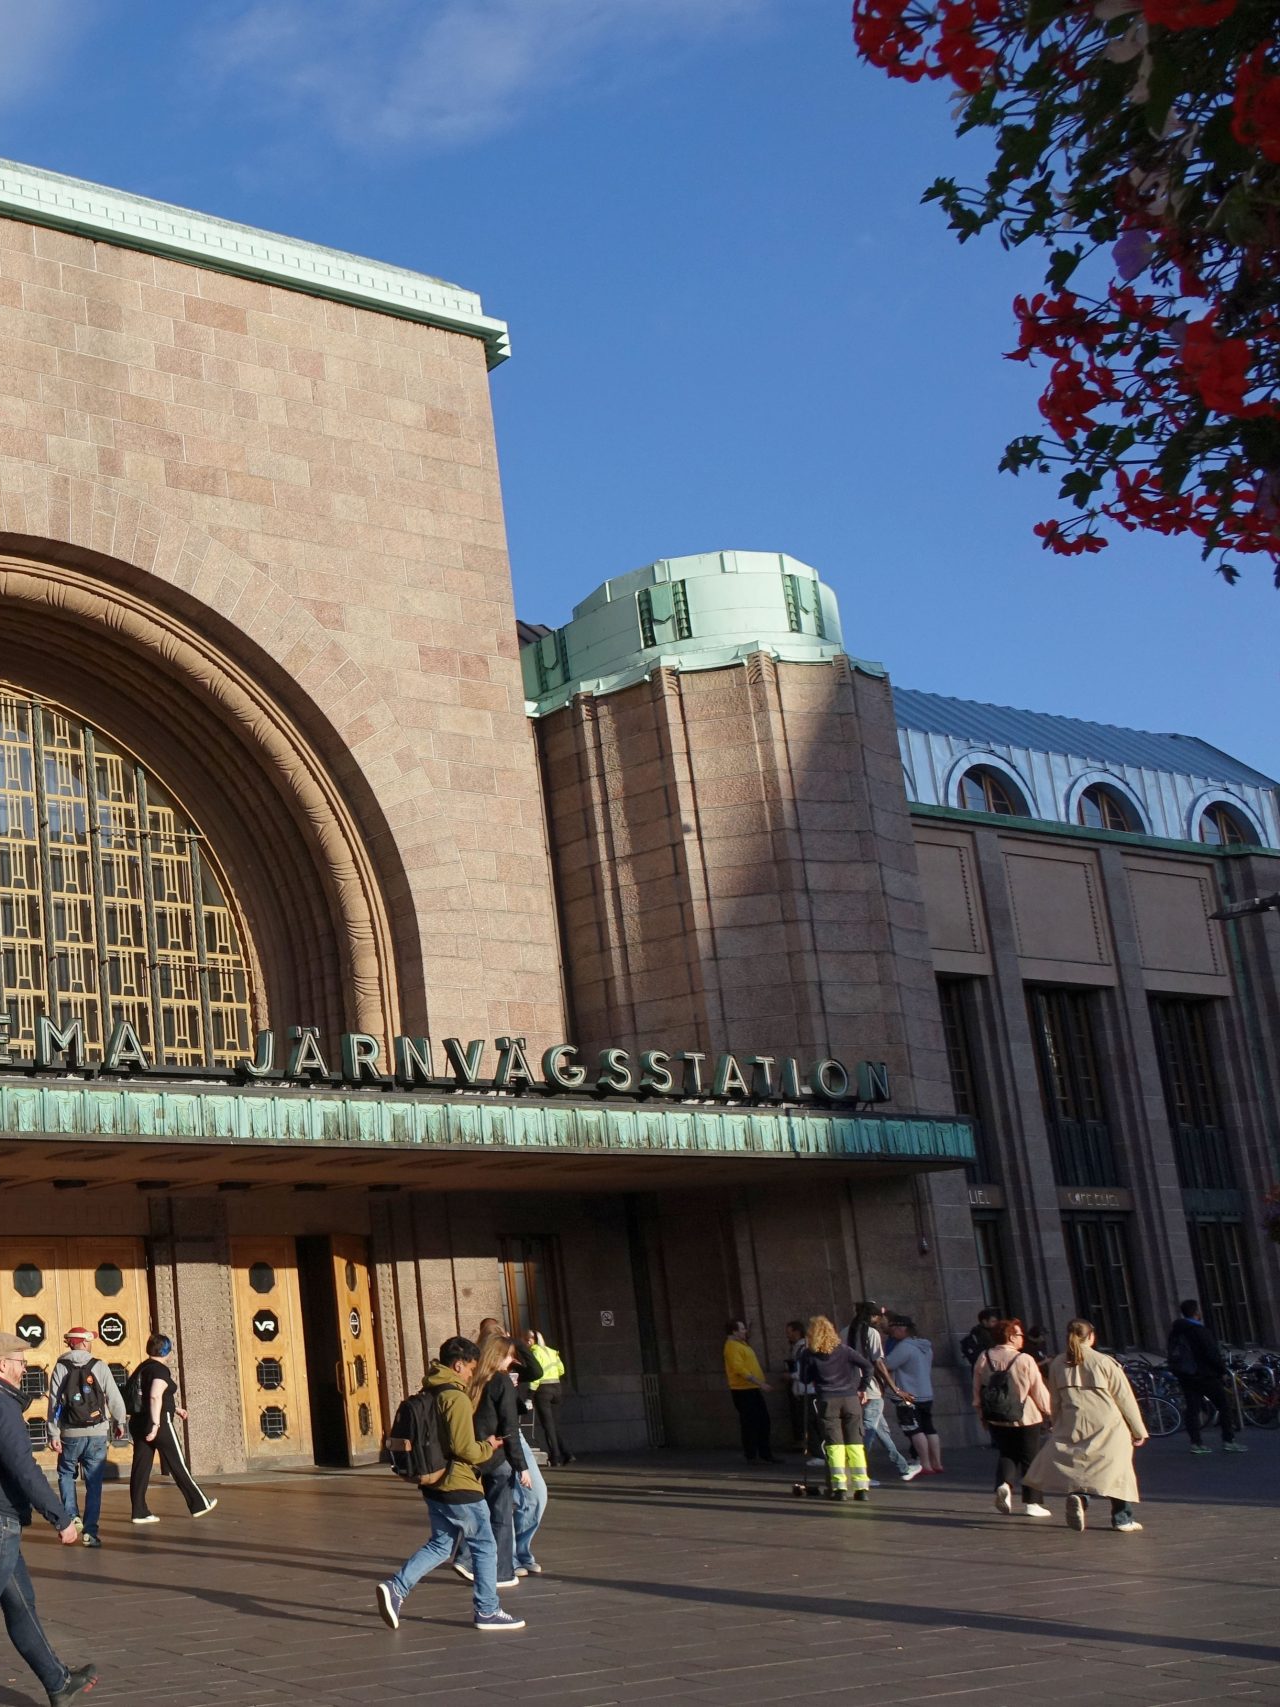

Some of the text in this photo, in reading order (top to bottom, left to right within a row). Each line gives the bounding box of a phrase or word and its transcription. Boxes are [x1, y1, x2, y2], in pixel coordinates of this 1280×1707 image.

[244, 1025, 891, 1101] JÄRNVÄGSSTATION
[255, 1320, 275, 1331] VR
[19, 1326, 42, 1337] VR
